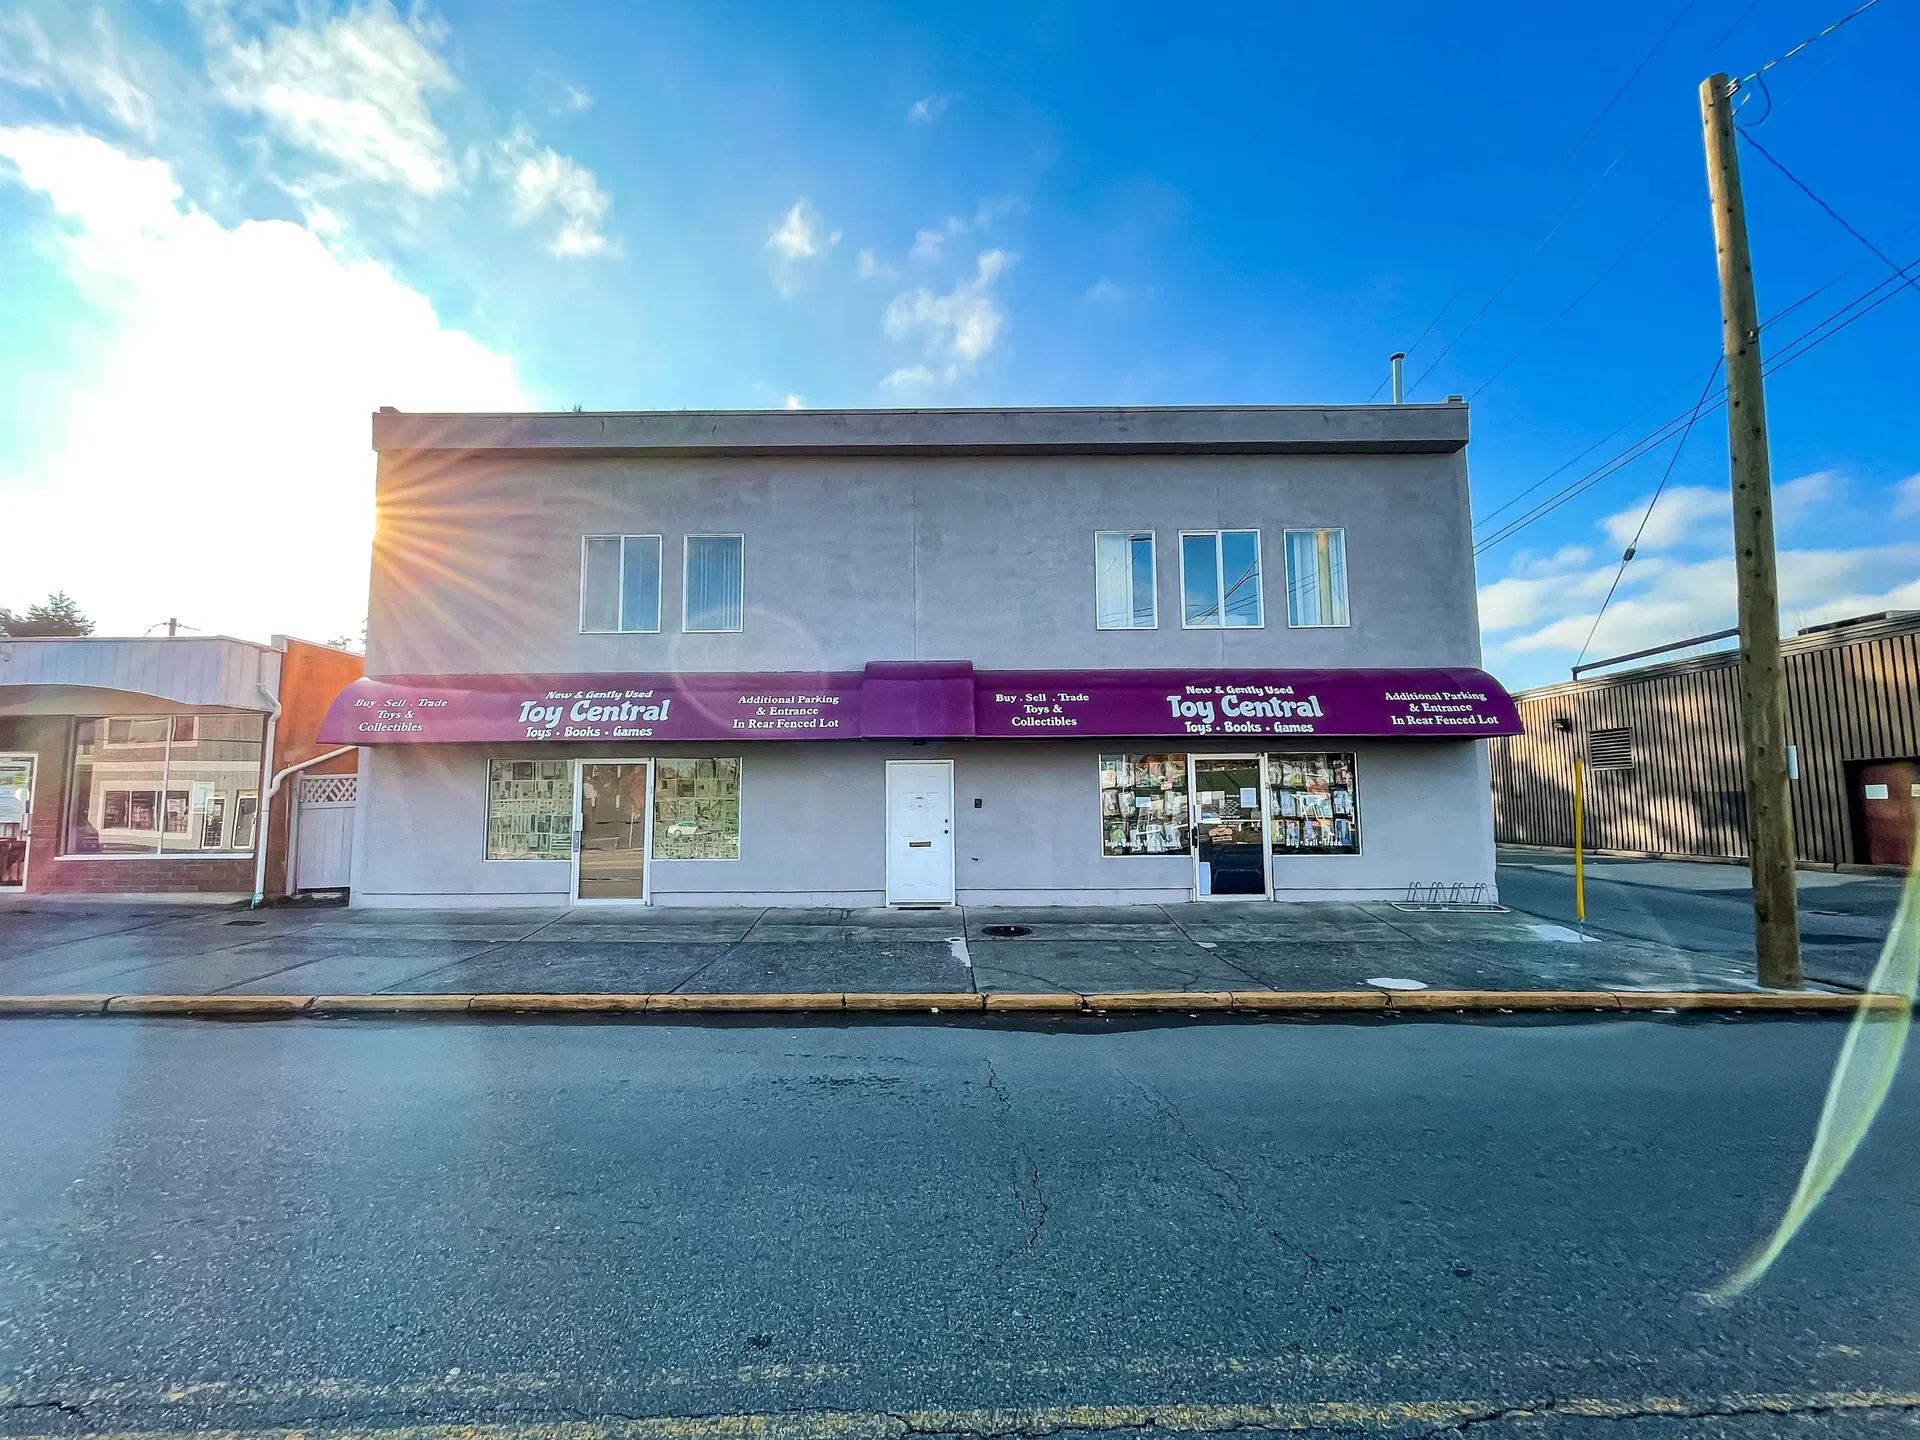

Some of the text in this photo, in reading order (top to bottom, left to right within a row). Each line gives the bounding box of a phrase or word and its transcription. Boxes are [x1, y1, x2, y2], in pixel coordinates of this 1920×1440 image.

[545, 690, 653, 700] New & Gently Used
[1185, 685, 1294, 696] New & Gently Used
[738, 695, 839, 705] Additional Parking
[995, 693, 1089, 703] Buy Sell Trade
[1385, 691, 1487, 702] Additional Parking
[354, 698, 447, 709] Buy Sell Trade
[1166, 694, 1324, 724] Toy Central
[1409, 702, 1473, 712] & Entrance
[377, 710, 415, 720] Toys &
[518, 699, 671, 728] Toy Central
[756, 706, 819, 716] & Entrance
[1024, 704, 1063, 715] Toys &
[733, 718, 839, 729] In Rear Fenced Lot
[1011, 716, 1077, 727] Collectibles
[1391, 714, 1499, 725] In Rear Fenced Lot
[358, 722, 423, 732] Collectibles
[525, 725, 653, 740] Toys Books Games
[1184, 721, 1314, 735] Toys Books Games
[1286, 839, 1342, 848] Buy Sell Trade
